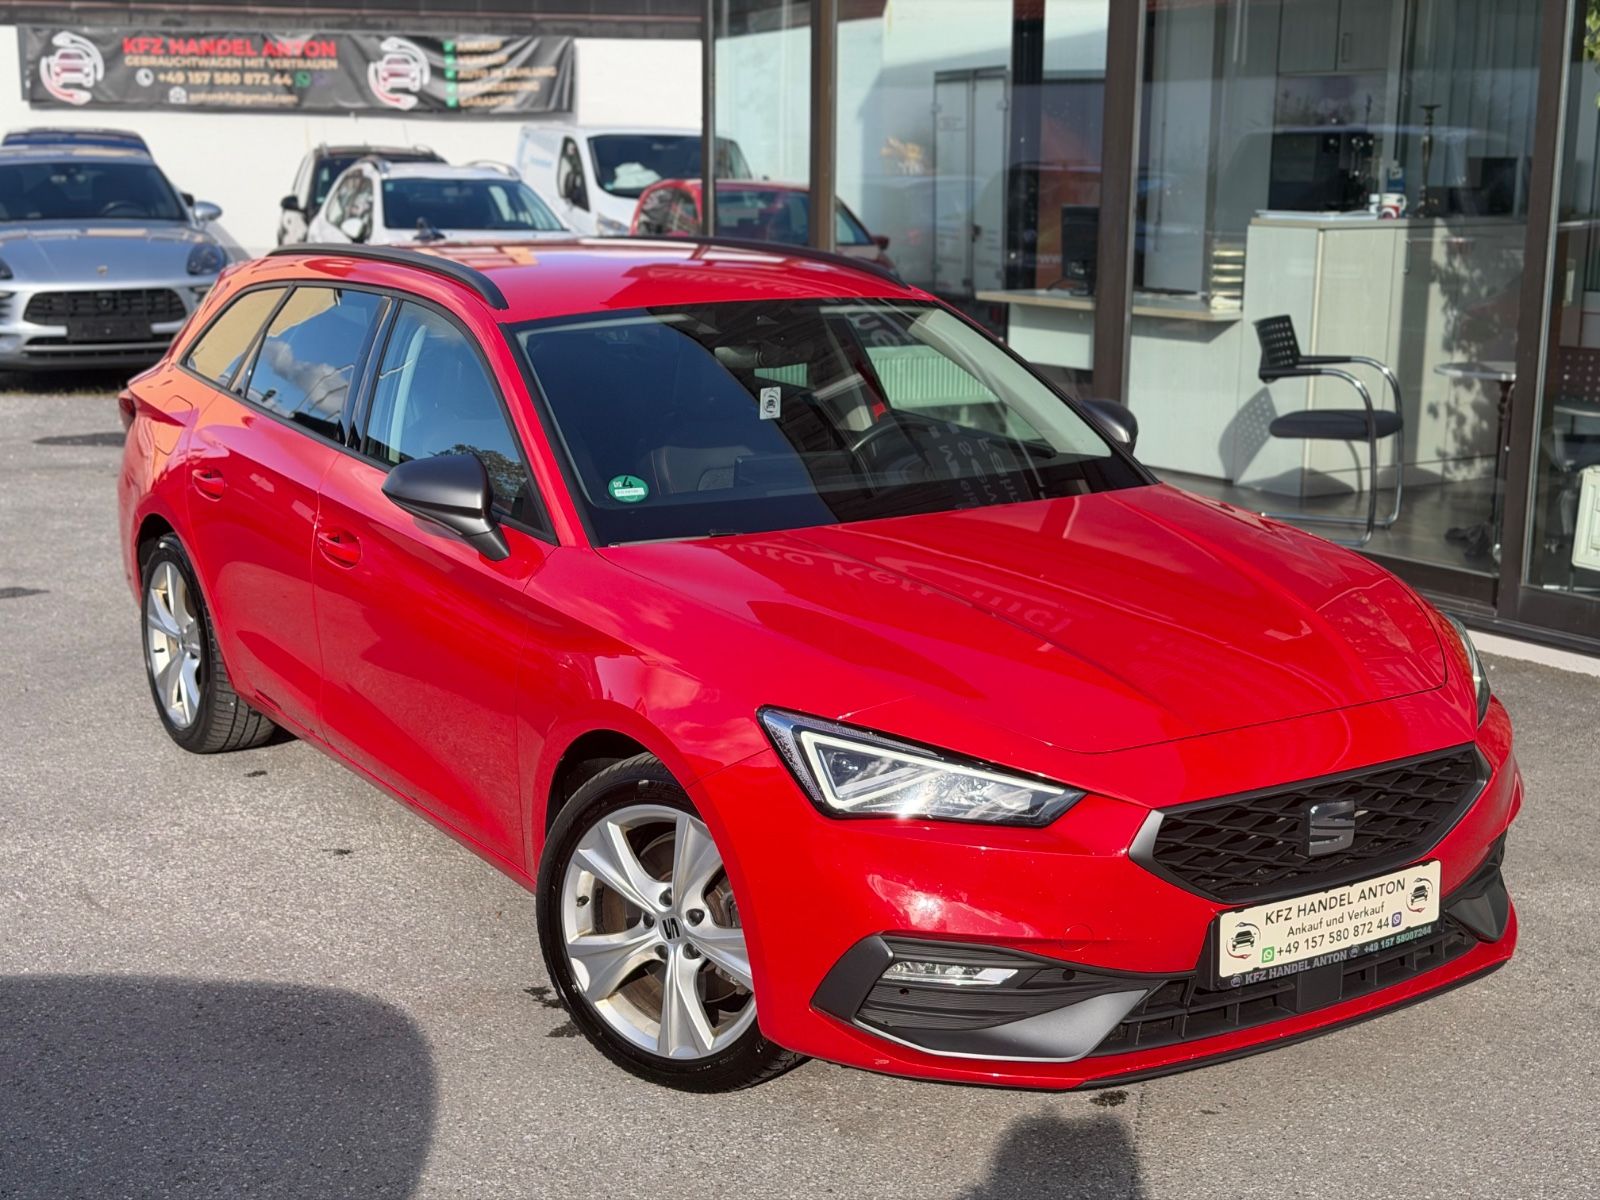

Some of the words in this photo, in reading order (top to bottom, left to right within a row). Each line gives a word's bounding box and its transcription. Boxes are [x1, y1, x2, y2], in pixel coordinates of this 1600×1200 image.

[122, 37, 165, 55] KFZ
[169, 38, 257, 56] HANDEL
[262, 40, 336, 57] ANTON
[124, 55, 242, 68] GEBRAUCHTWAGEN
[244, 57, 265, 69] MIT
[268, 58, 338, 70] VERTRAUEN
[158, 71, 185, 85] +49
[187, 71, 210, 85] 157
[213, 72, 240, 86] 580
[244, 72, 270, 86] 872
[272, 73, 292, 86] 44
[1265, 907, 1293, 926] KFZ
[1297, 891, 1353, 918] HANDEL
[1358, 877, 1405, 903] ANTON
[1287, 917, 1324, 938] Ankauf
[1326, 912, 1344, 927] und
[1347, 901, 1385, 921] Verkauf
[1276, 940, 1300, 957] +49
[1304, 934, 1325, 951] 157
[1328, 928, 1349, 944] 580
[1353, 921, 1373, 938] 872
[1376, 916, 1390, 930] 44
[1245, 970, 1267, 984] KFZ
[1268, 960, 1311, 980] HANDEL
[1312, 950, 1347, 969] ANTON
[1364, 942, 1380, 954] +49
[1380, 937, 1395, 949] 157
